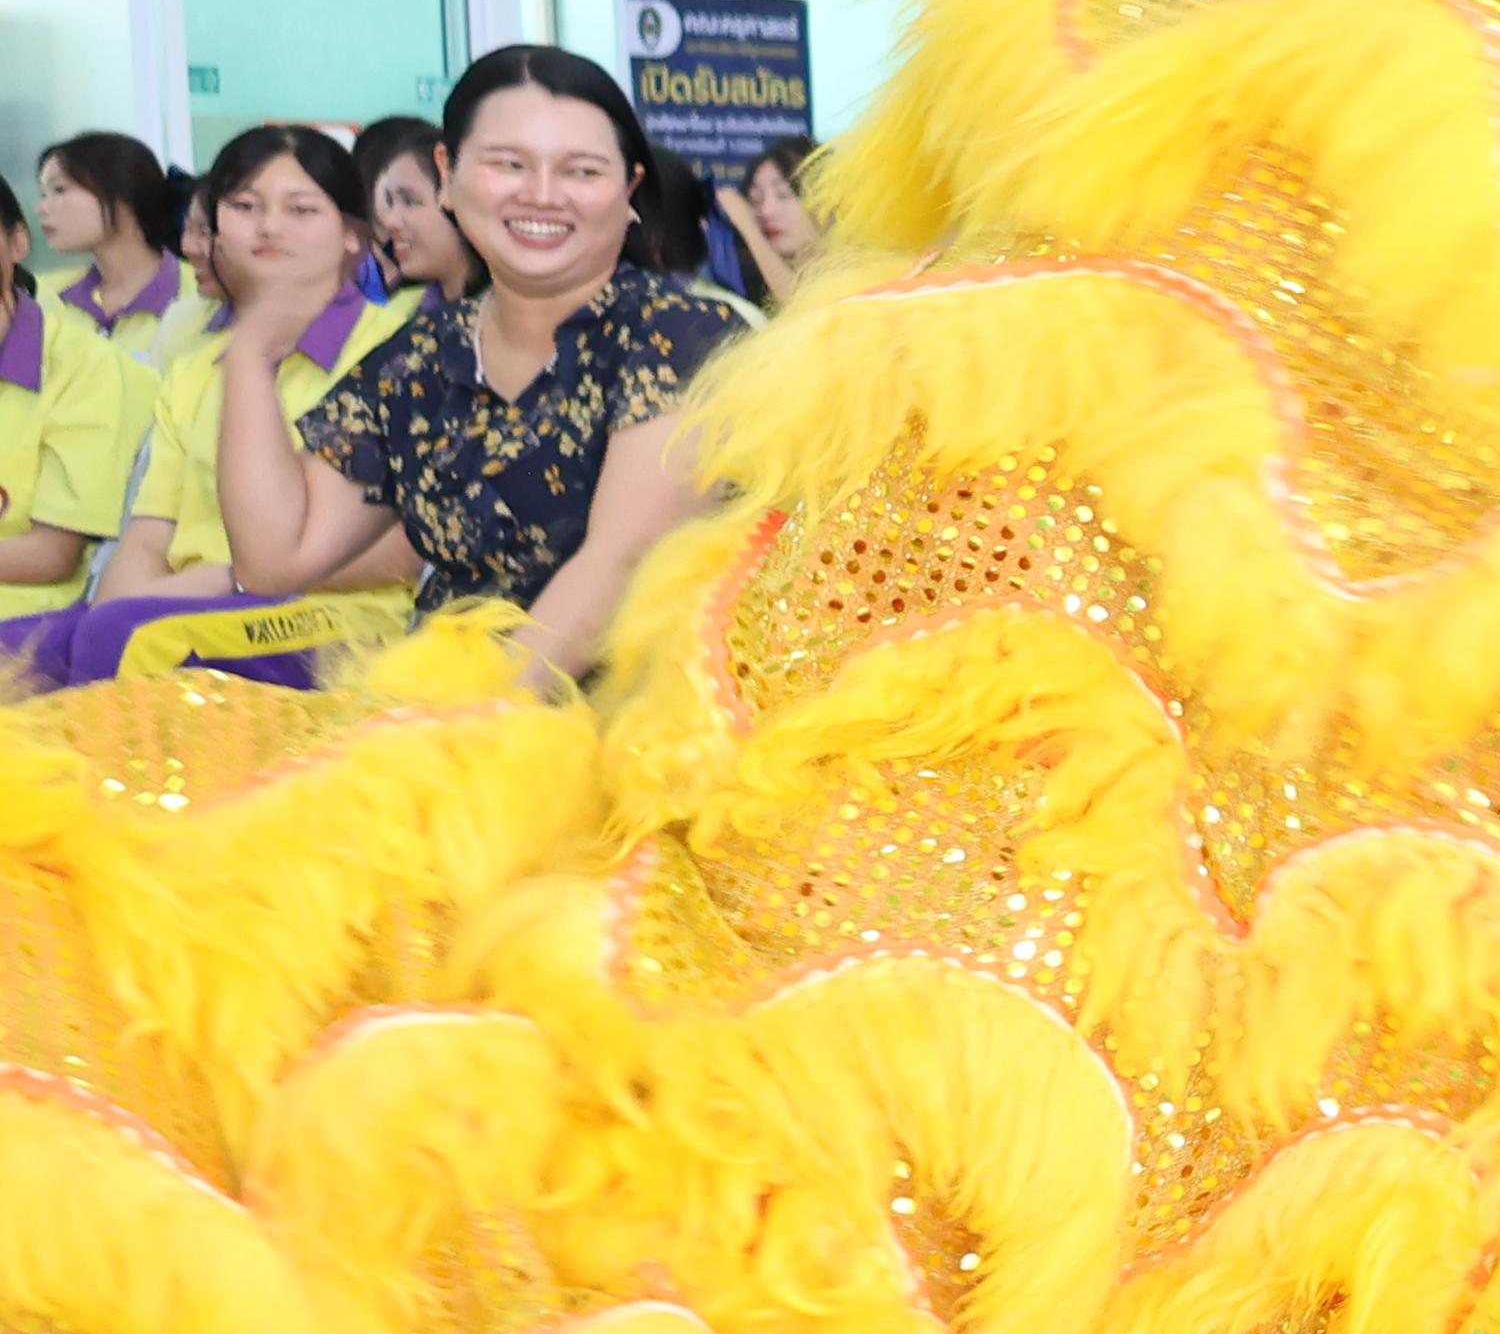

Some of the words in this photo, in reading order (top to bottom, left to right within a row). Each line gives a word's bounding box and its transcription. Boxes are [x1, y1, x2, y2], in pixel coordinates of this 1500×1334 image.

[641, 64, 806, 109] เปิดรับสมัคร
